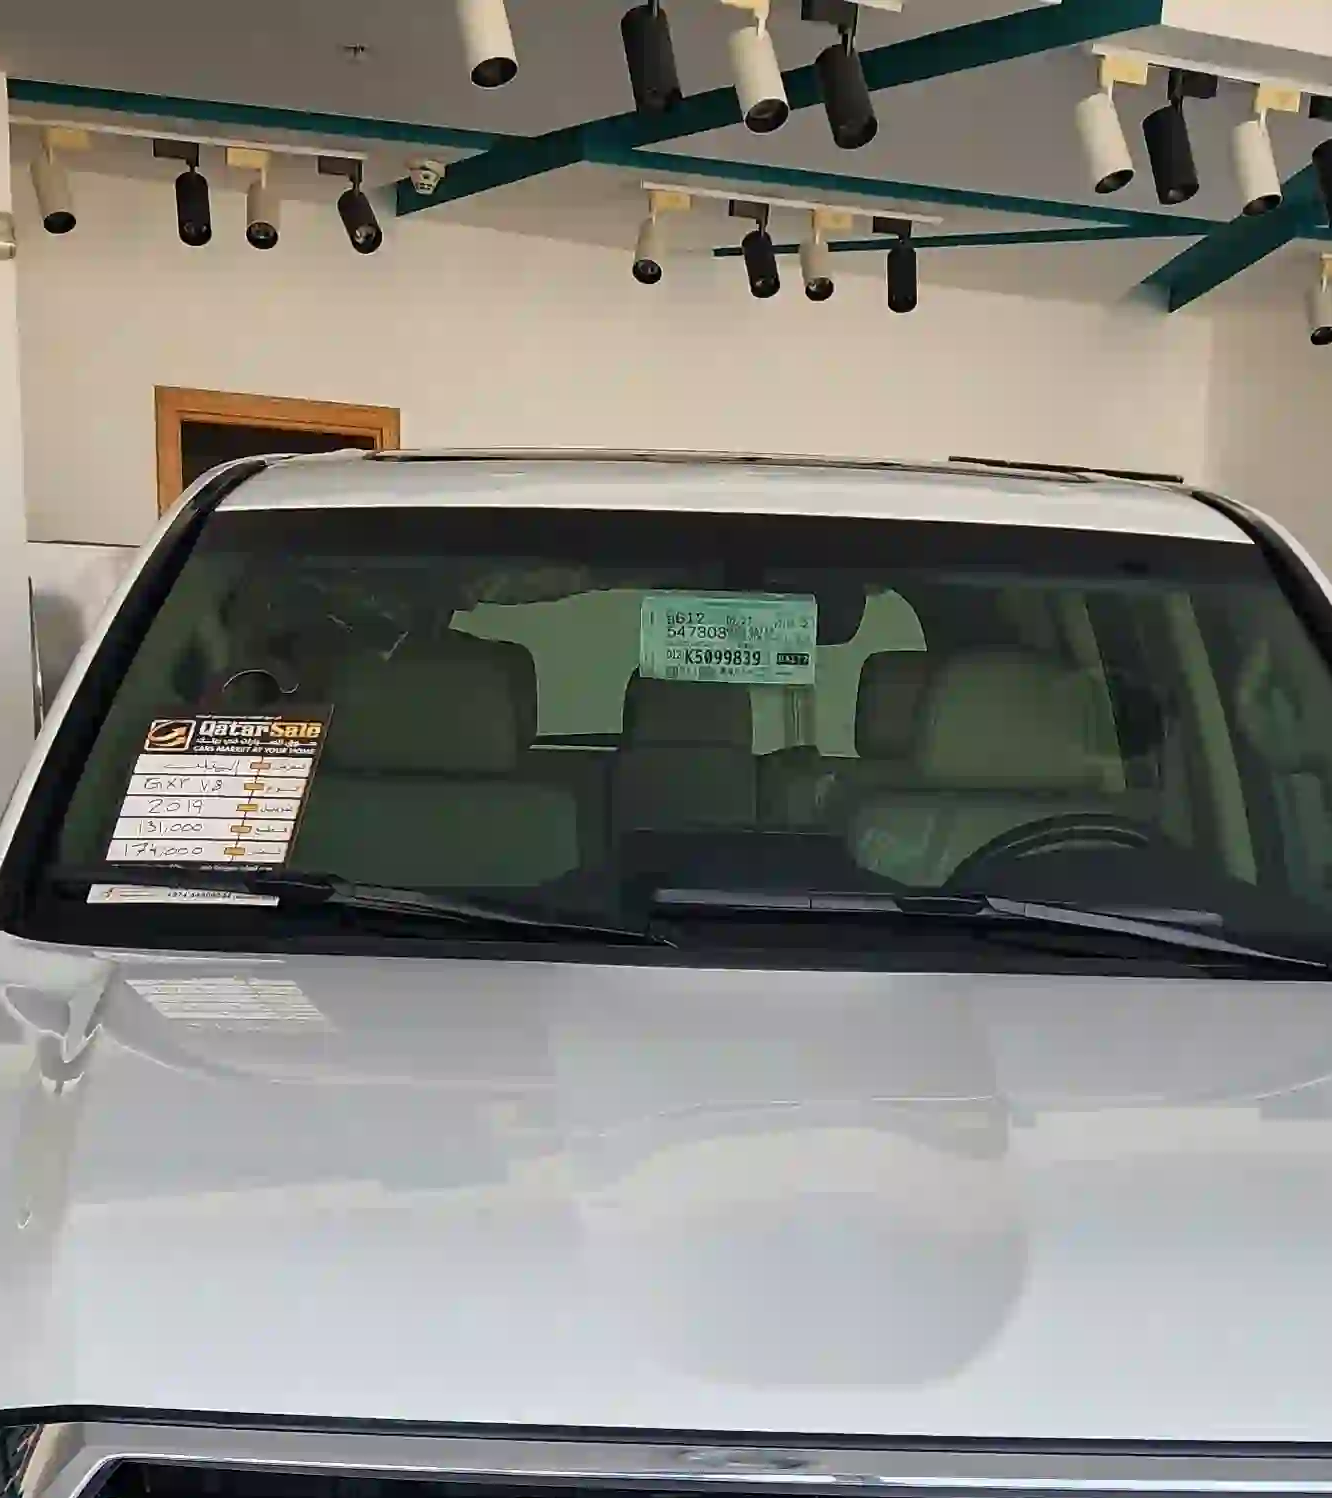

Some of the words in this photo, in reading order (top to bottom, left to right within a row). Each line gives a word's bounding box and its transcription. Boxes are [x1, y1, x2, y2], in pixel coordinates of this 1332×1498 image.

[685, 650, 761, 666] K5099839
[199, 721, 322, 738] QatarSale
[148, 800, 204, 814] 2019
